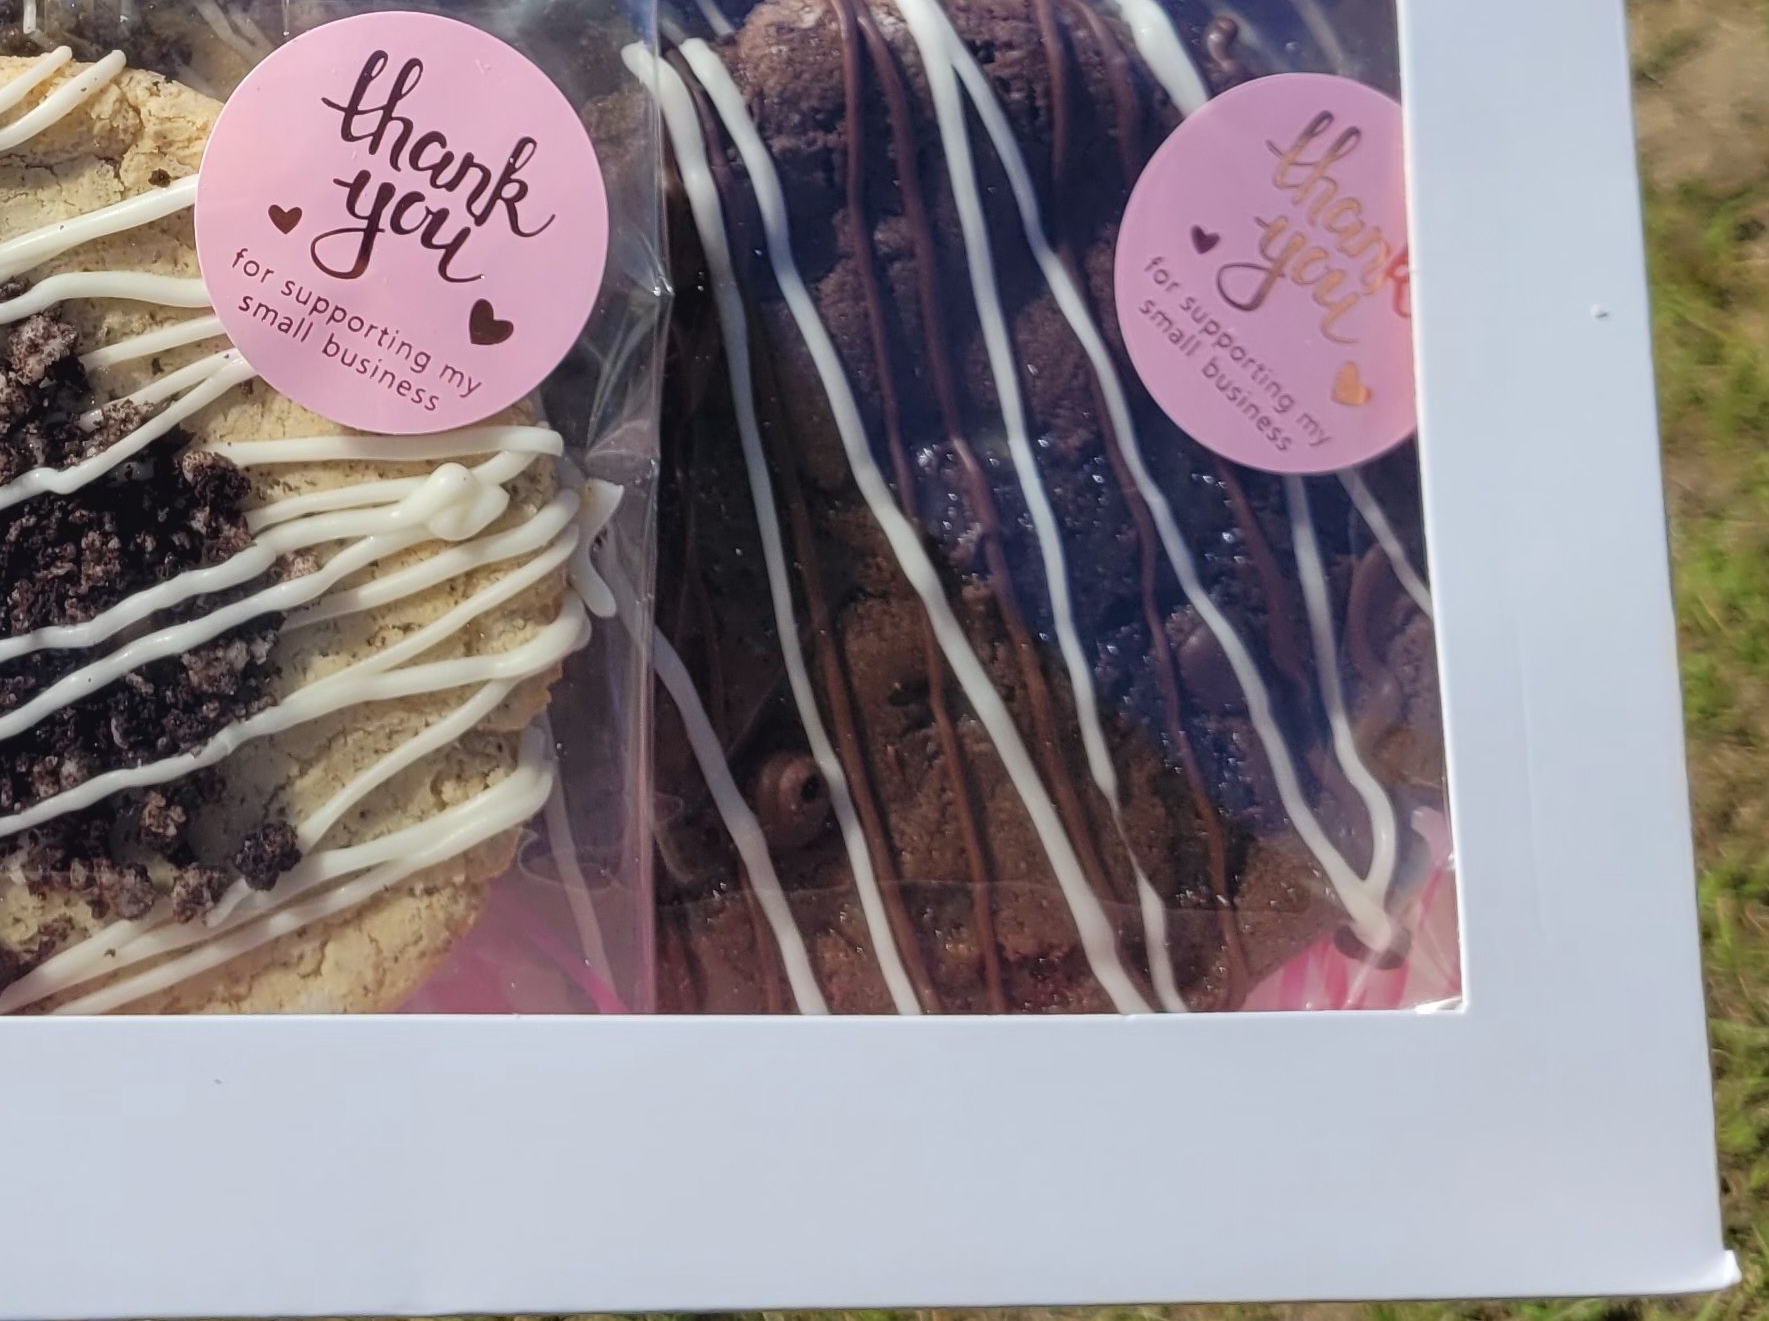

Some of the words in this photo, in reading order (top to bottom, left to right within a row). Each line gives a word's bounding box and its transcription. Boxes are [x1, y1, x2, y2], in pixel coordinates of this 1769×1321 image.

[321, 50, 556, 238] thank
[310, 169, 485, 283] you
[1216, 215, 1360, 344] you
[232, 248, 274, 283] for
[280, 277, 432, 373] supporting
[443, 364, 483, 399] my
[239, 294, 313, 343] small
[322, 335, 440, 412] business
[1139, 299, 1202, 358] small
[1202, 357, 1292, 452] business
[1144, 256, 1181, 290] for
[1180, 296, 1295, 414] supporting
[1295, 410, 1330, 448] my
